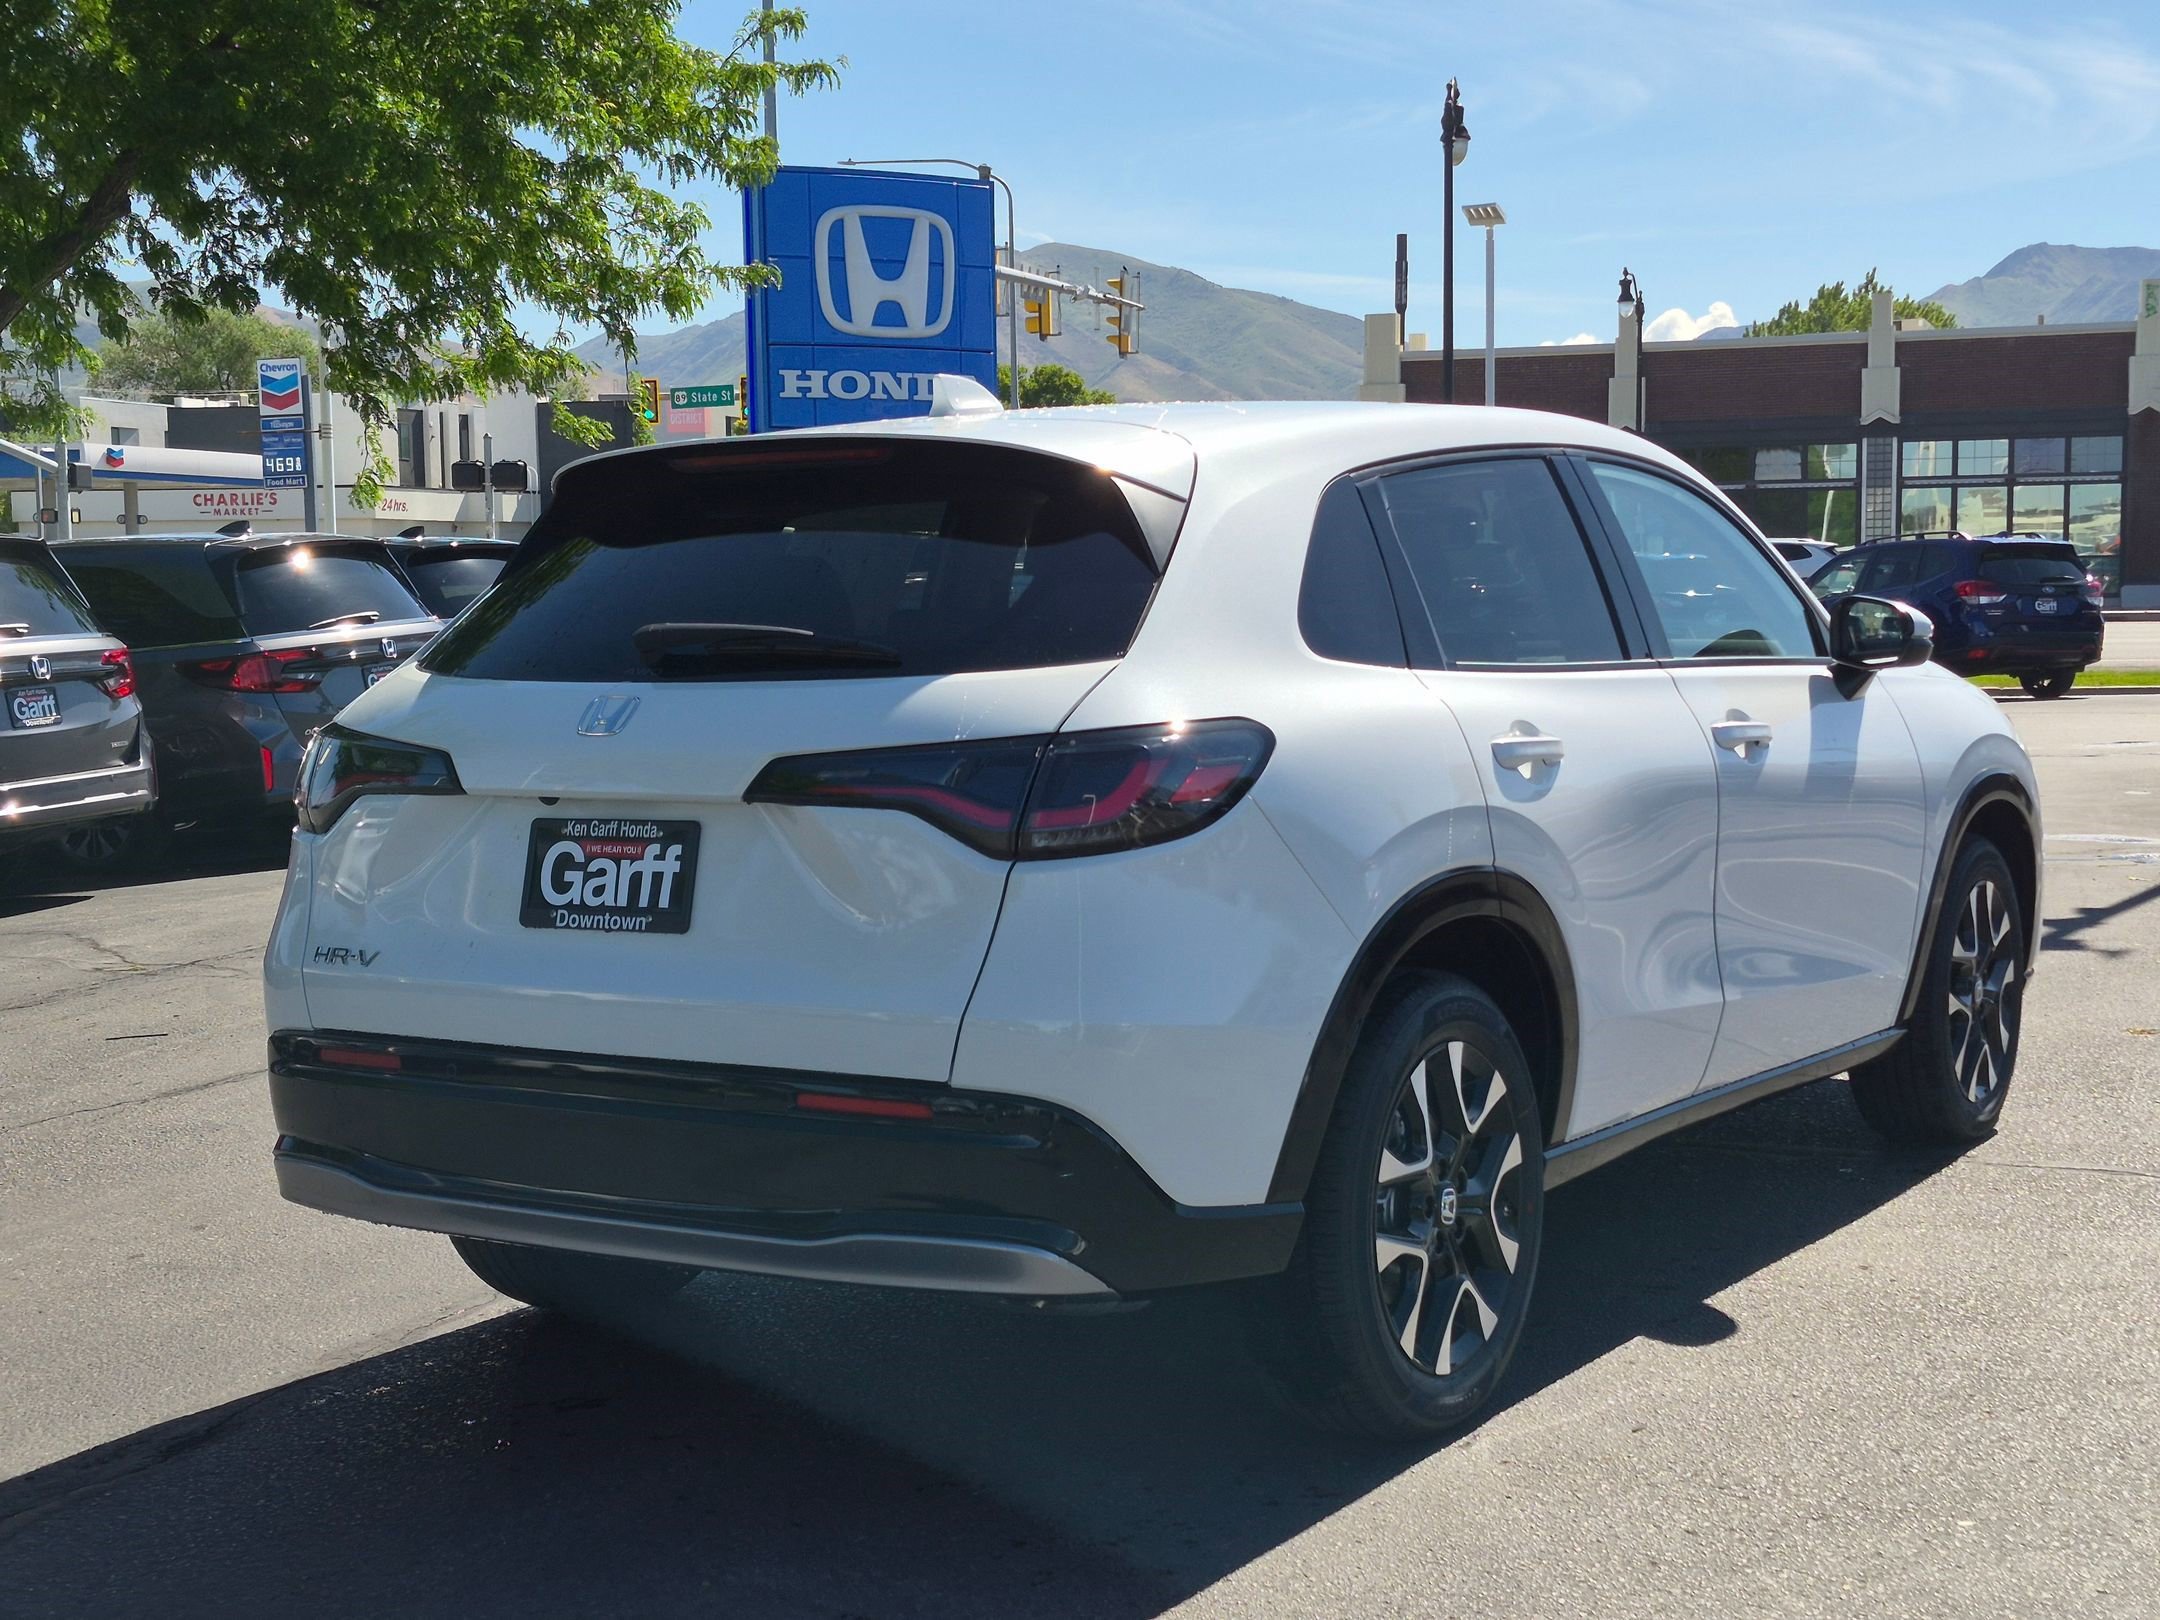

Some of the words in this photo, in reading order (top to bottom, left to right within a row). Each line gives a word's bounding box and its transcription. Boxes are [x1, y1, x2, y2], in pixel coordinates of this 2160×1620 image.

[260, 363, 298, 372] Chevron
[779, 370, 937, 400] HON
[676, 393, 686, 403] 89
[691, 391, 718, 402] State
[721, 390, 731, 401] St
[266, 479, 285, 487] Food
[286, 478, 303, 486] Mart
[192, 492, 278, 507] CHARLIE'S
[381, 498, 393, 511] 24
[393, 499, 408, 512] hrs.
[213, 507, 260, 516] MARKET
[13, 694, 56, 720] Garff
[566, 820, 587, 837] Ken
[590, 820, 618, 838] Garff
[620, 820, 657, 838] Honda
[591, 845, 603, 853] WE
[602, 845, 622, 853] HEAR
[622, 845, 637, 854] YOU
[540, 840, 682, 909] Garff
[555, 909, 647, 931] Downtown
[313, 946, 381, 967] HR-V
